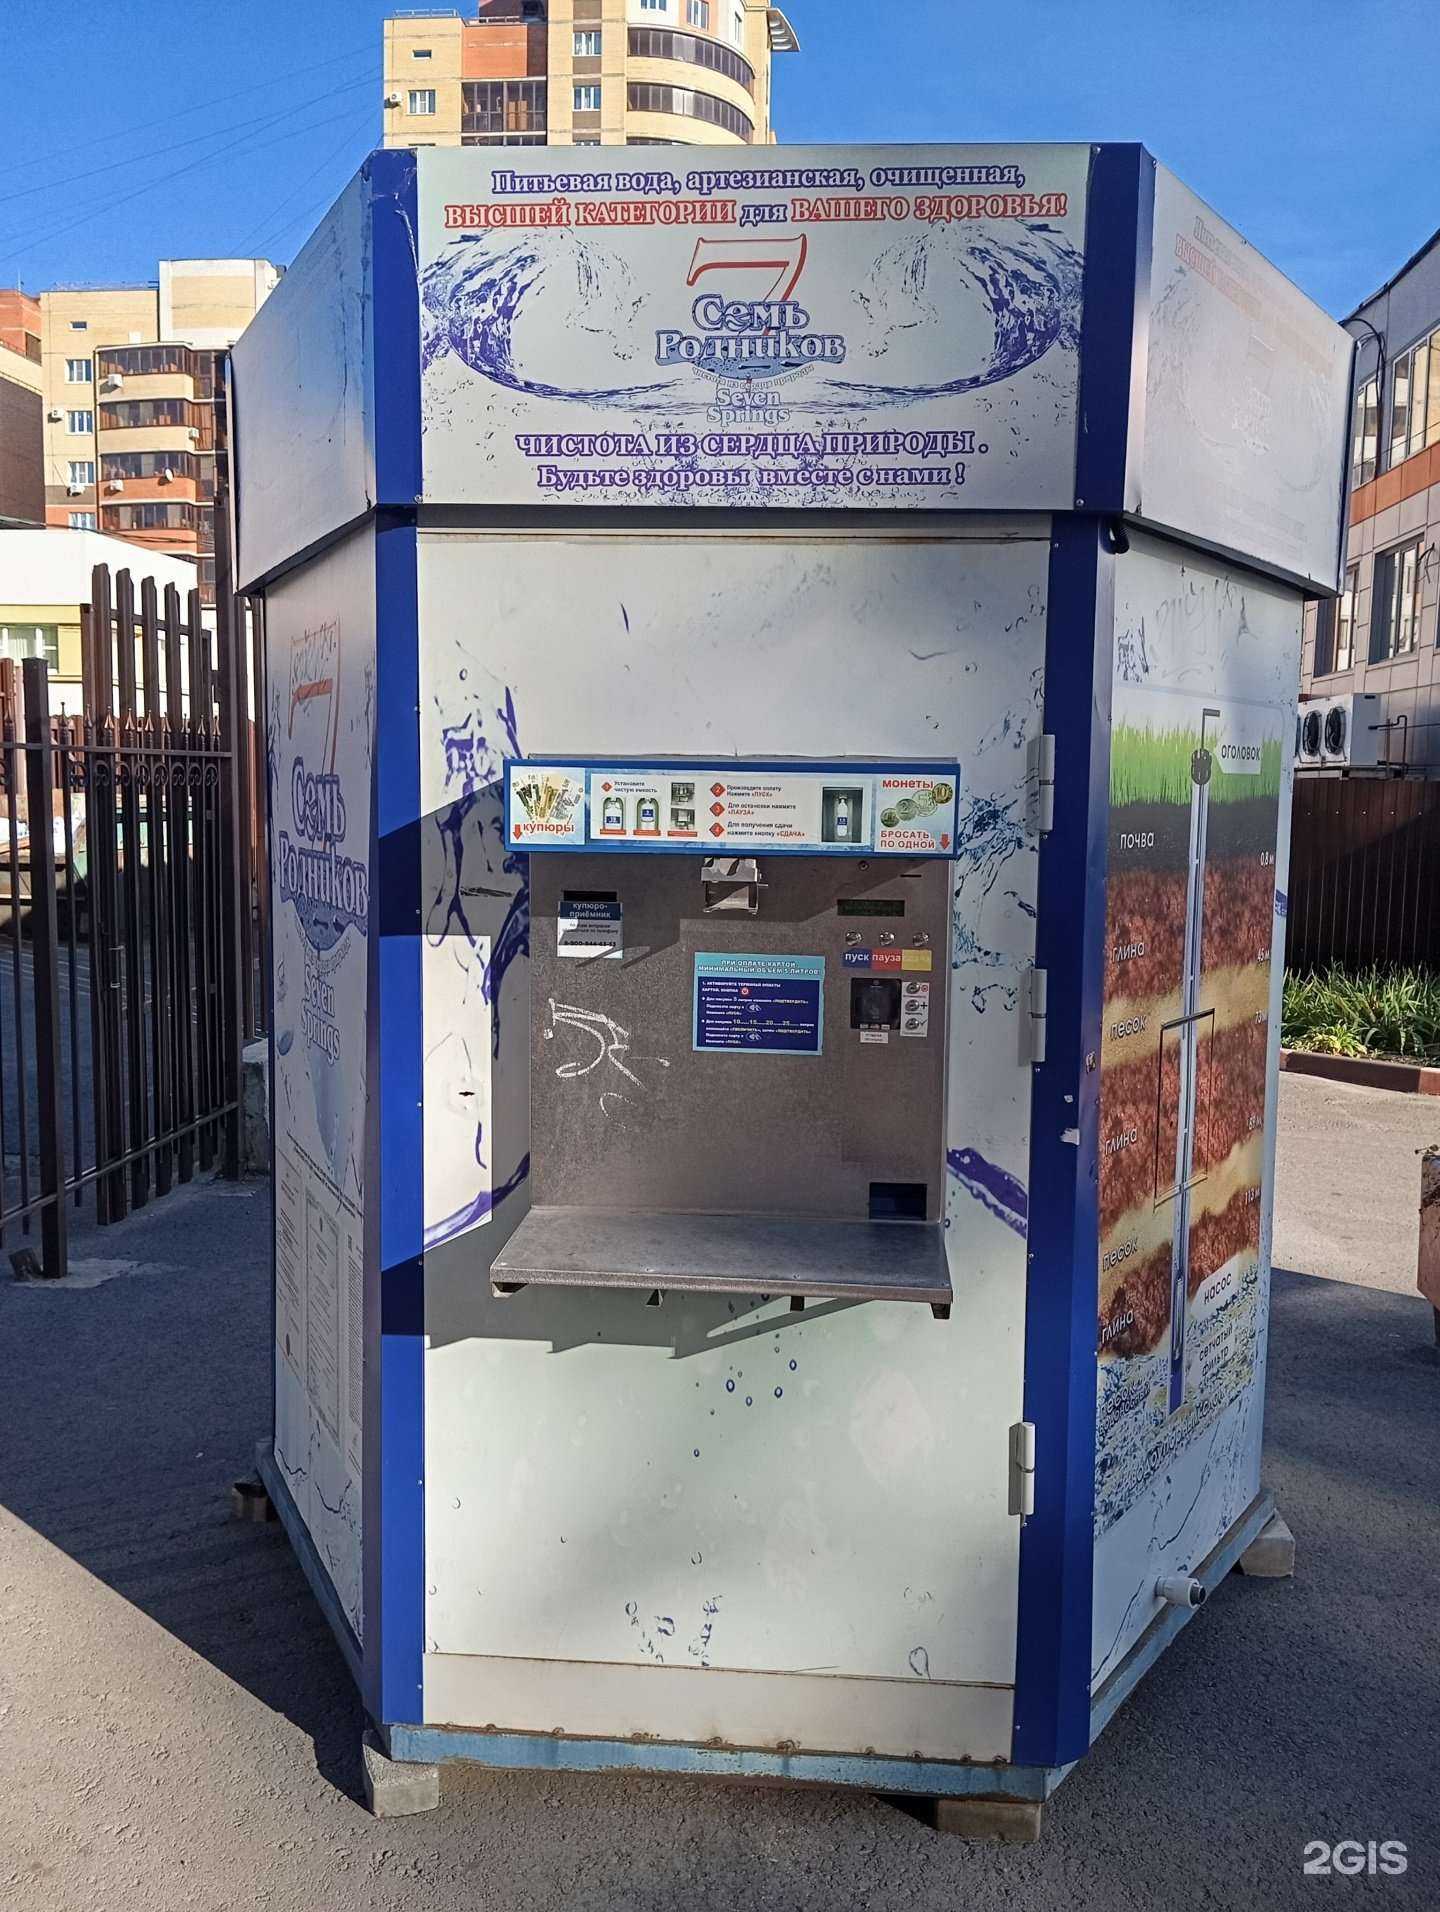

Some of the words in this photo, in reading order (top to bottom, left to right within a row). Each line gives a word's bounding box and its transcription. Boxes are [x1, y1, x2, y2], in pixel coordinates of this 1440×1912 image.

[492, 170, 611, 194] Питьевая
[616, 171, 682, 194] вода,
[687, 168, 864, 194] артезианская,
[869, 165, 1025, 189] очищенная,
[444, 198, 570, 228] ВЫСШЕЙ
[575, 200, 737, 226] КАТЕГОРИИ
[739, 204, 787, 227] для
[791, 197, 910, 222] ВАШЕГО
[914, 193, 1067, 223] ЗДОРОВЬЯ!
[687, 233, 808, 335] 7
[692, 294, 810, 331] Семь
[655, 328, 846, 361] Родников
[716, 387, 781, 405] Seven
[706, 406, 791, 427] Springs
[515, 434, 652, 457] ЧИСТОТА
[655, 434, 700, 457] ИЗ
[700, 433, 822, 459] СЕРДЦА
[538, 464, 630, 491] Будьте
[632, 468, 751, 491] здоровы
[758, 467, 853, 486] вместе
[857, 467, 874, 486] с
[1220, 743, 1261, 761] оголовок
[292, 756, 346, 843] Семь
[523, 823, 575, 834] купюры
[881, 831, 929, 839] БРОСАТЬ
[1120, 831, 1154, 850] почва
[898, 839, 935, 849] ОДНОЙ
[278, 831, 368, 919] Родников
[845, 953, 869, 962] пуск
[872, 953, 901, 963] пауза
[1111, 942, 1145, 964] глина
[304, 963, 335, 1018] Seven
[301, 998, 340, 1065] Springs
[1110, 1015, 1147, 1041] песок
[1104, 1126, 1137, 1156] глина
[1102, 1240, 1139, 1273] песок
[1203, 1273, 1232, 1305] насос
[1101, 1308, 1135, 1344] глина
